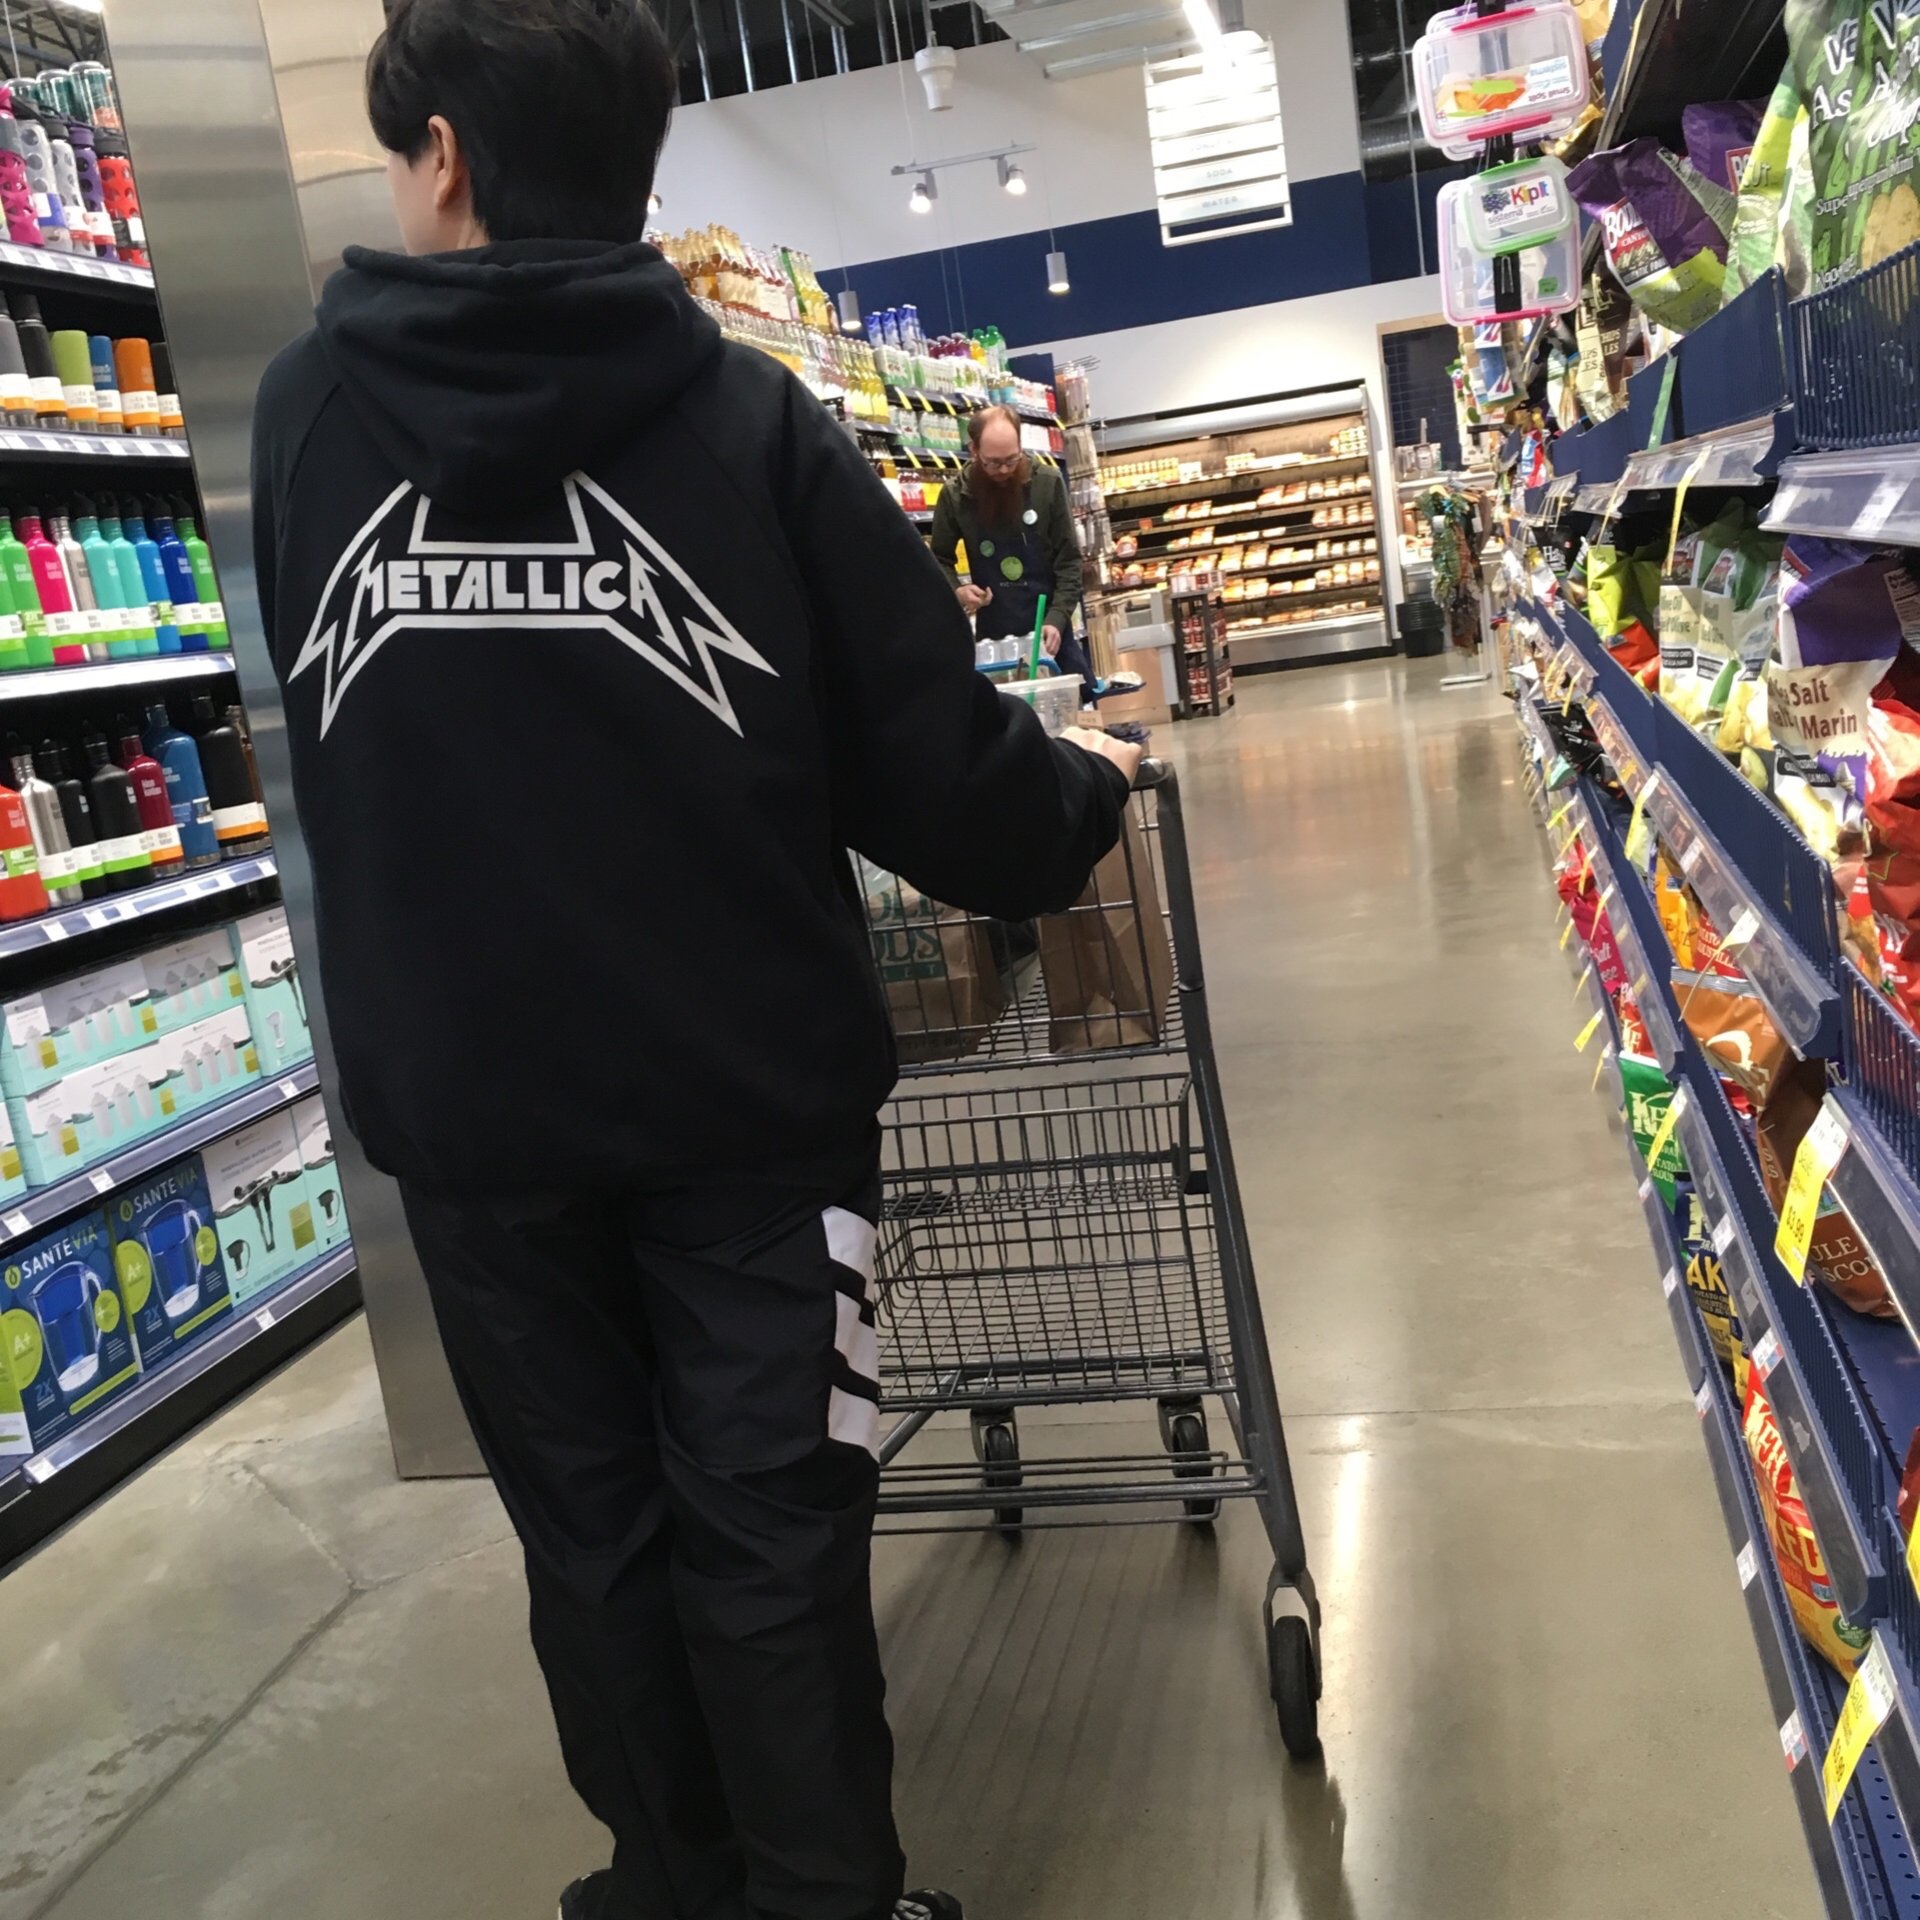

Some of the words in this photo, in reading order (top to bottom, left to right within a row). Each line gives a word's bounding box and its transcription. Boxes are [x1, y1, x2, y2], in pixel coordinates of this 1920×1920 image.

[1206, 168, 1233, 178] SODA
[1202, 196, 1239, 208] WATER
[339, 539, 691, 671] METALLICA
[1789, 677, 1831, 707] Salt
[1800, 707, 1858, 740] Marin
[133, 1167, 198, 1215] SANTEVIA
[21, 1225, 98, 1279] SANTEVIA
[126, 1262, 142, 1281] A+
[143, 1305, 160, 1323] 2X
[14, 1331, 31, 1354] A+
[35, 1380, 52, 1400] 2X
[1849, 1678, 1864, 1720] Sale
